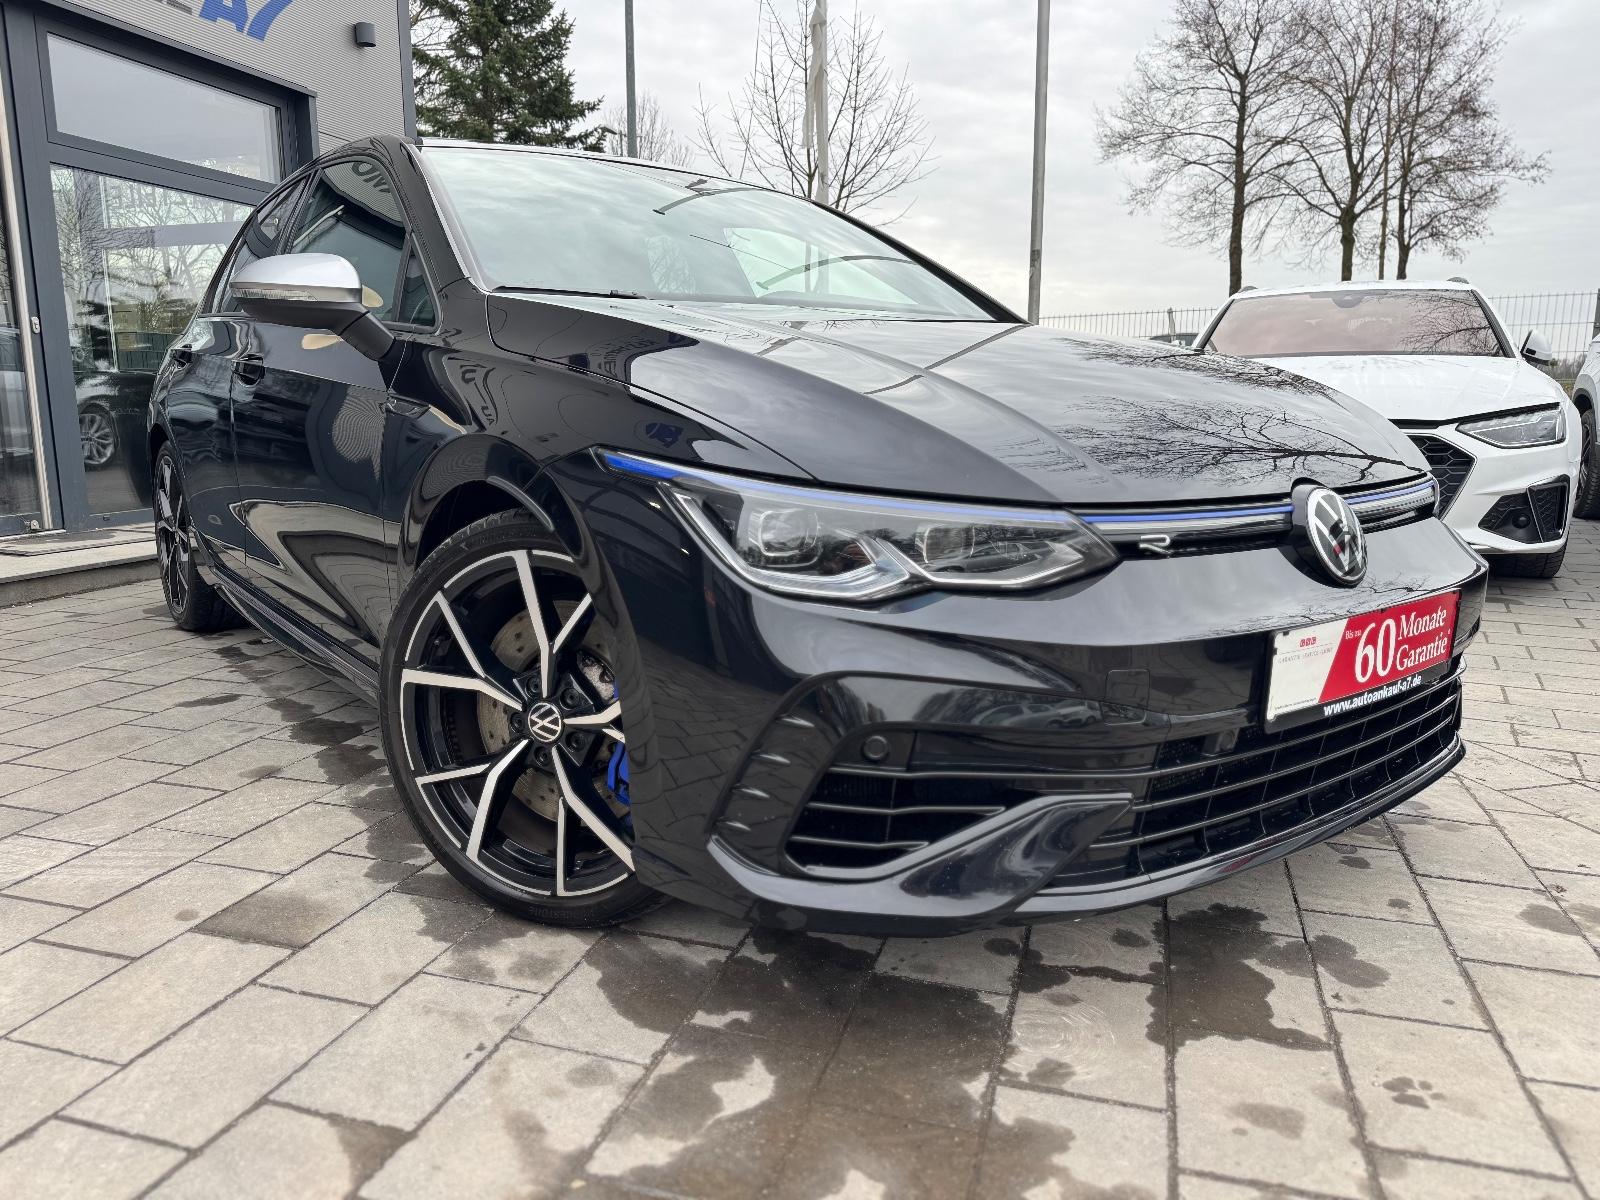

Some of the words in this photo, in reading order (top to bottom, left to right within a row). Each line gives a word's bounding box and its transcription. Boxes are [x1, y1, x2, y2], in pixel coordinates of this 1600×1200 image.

[1139, 534, 1173, 554] R
[1345, 629, 1354, 640] Bis
[1398, 605, 1447, 640] Monate
[1355, 618, 1397, 683] 60
[1396, 631, 1448, 671] Garantie
[1323, 674, 1422, 717] www.autoankauf-a7.de
